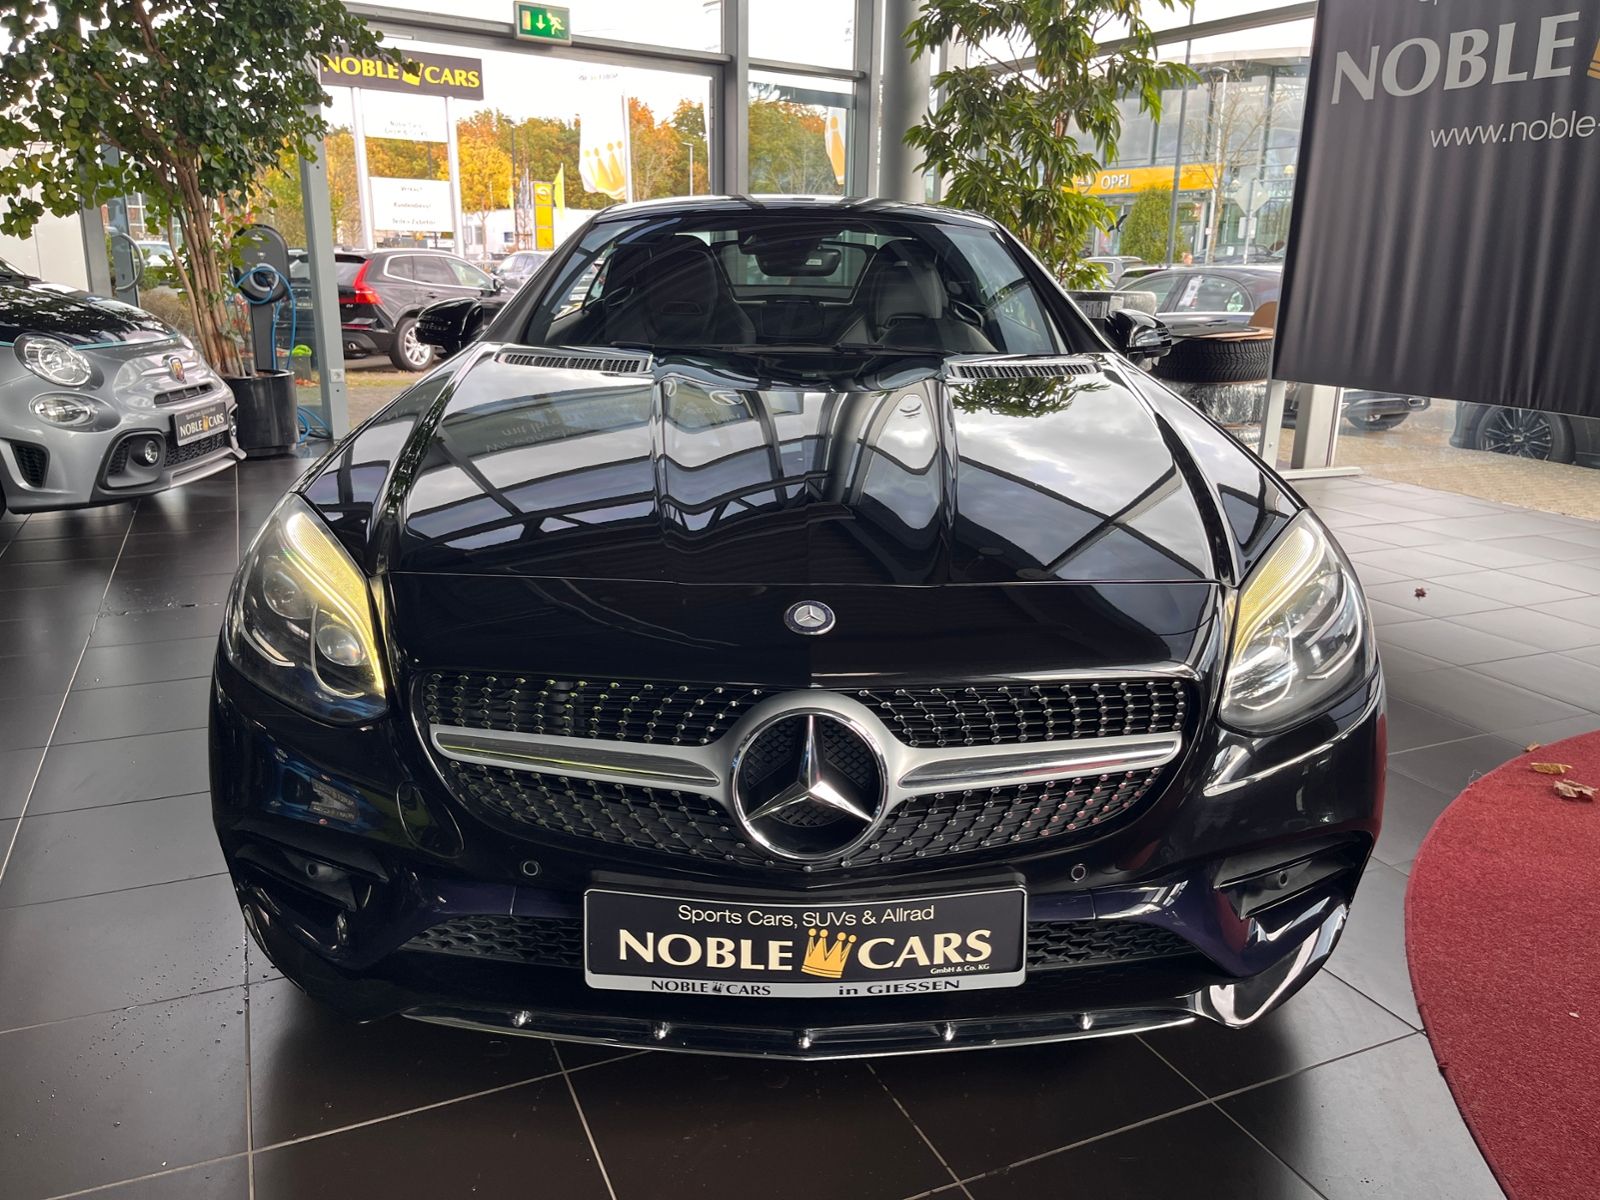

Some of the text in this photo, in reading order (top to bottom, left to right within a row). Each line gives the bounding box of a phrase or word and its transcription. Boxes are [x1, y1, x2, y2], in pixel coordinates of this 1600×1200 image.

[1331, 11, 1580, 105] NOBLE
[323, 54, 480, 88] NOBLE CARS
[1431, 110, 1600, 148] www.noble
[1101, 174, 1130, 190] OPEL
[180, 420, 203, 437] NOBLE
[208, 413, 225, 427] CARS
[678, 904, 935, 929] Sports Cars, SUVs & Allrad
[619, 928, 992, 971] NOBLE CARS
[930, 966, 955, 975] GmbH
[651, 980, 771, 996] NOBLE CARS
[839, 980, 960, 996] in GIESSEN
